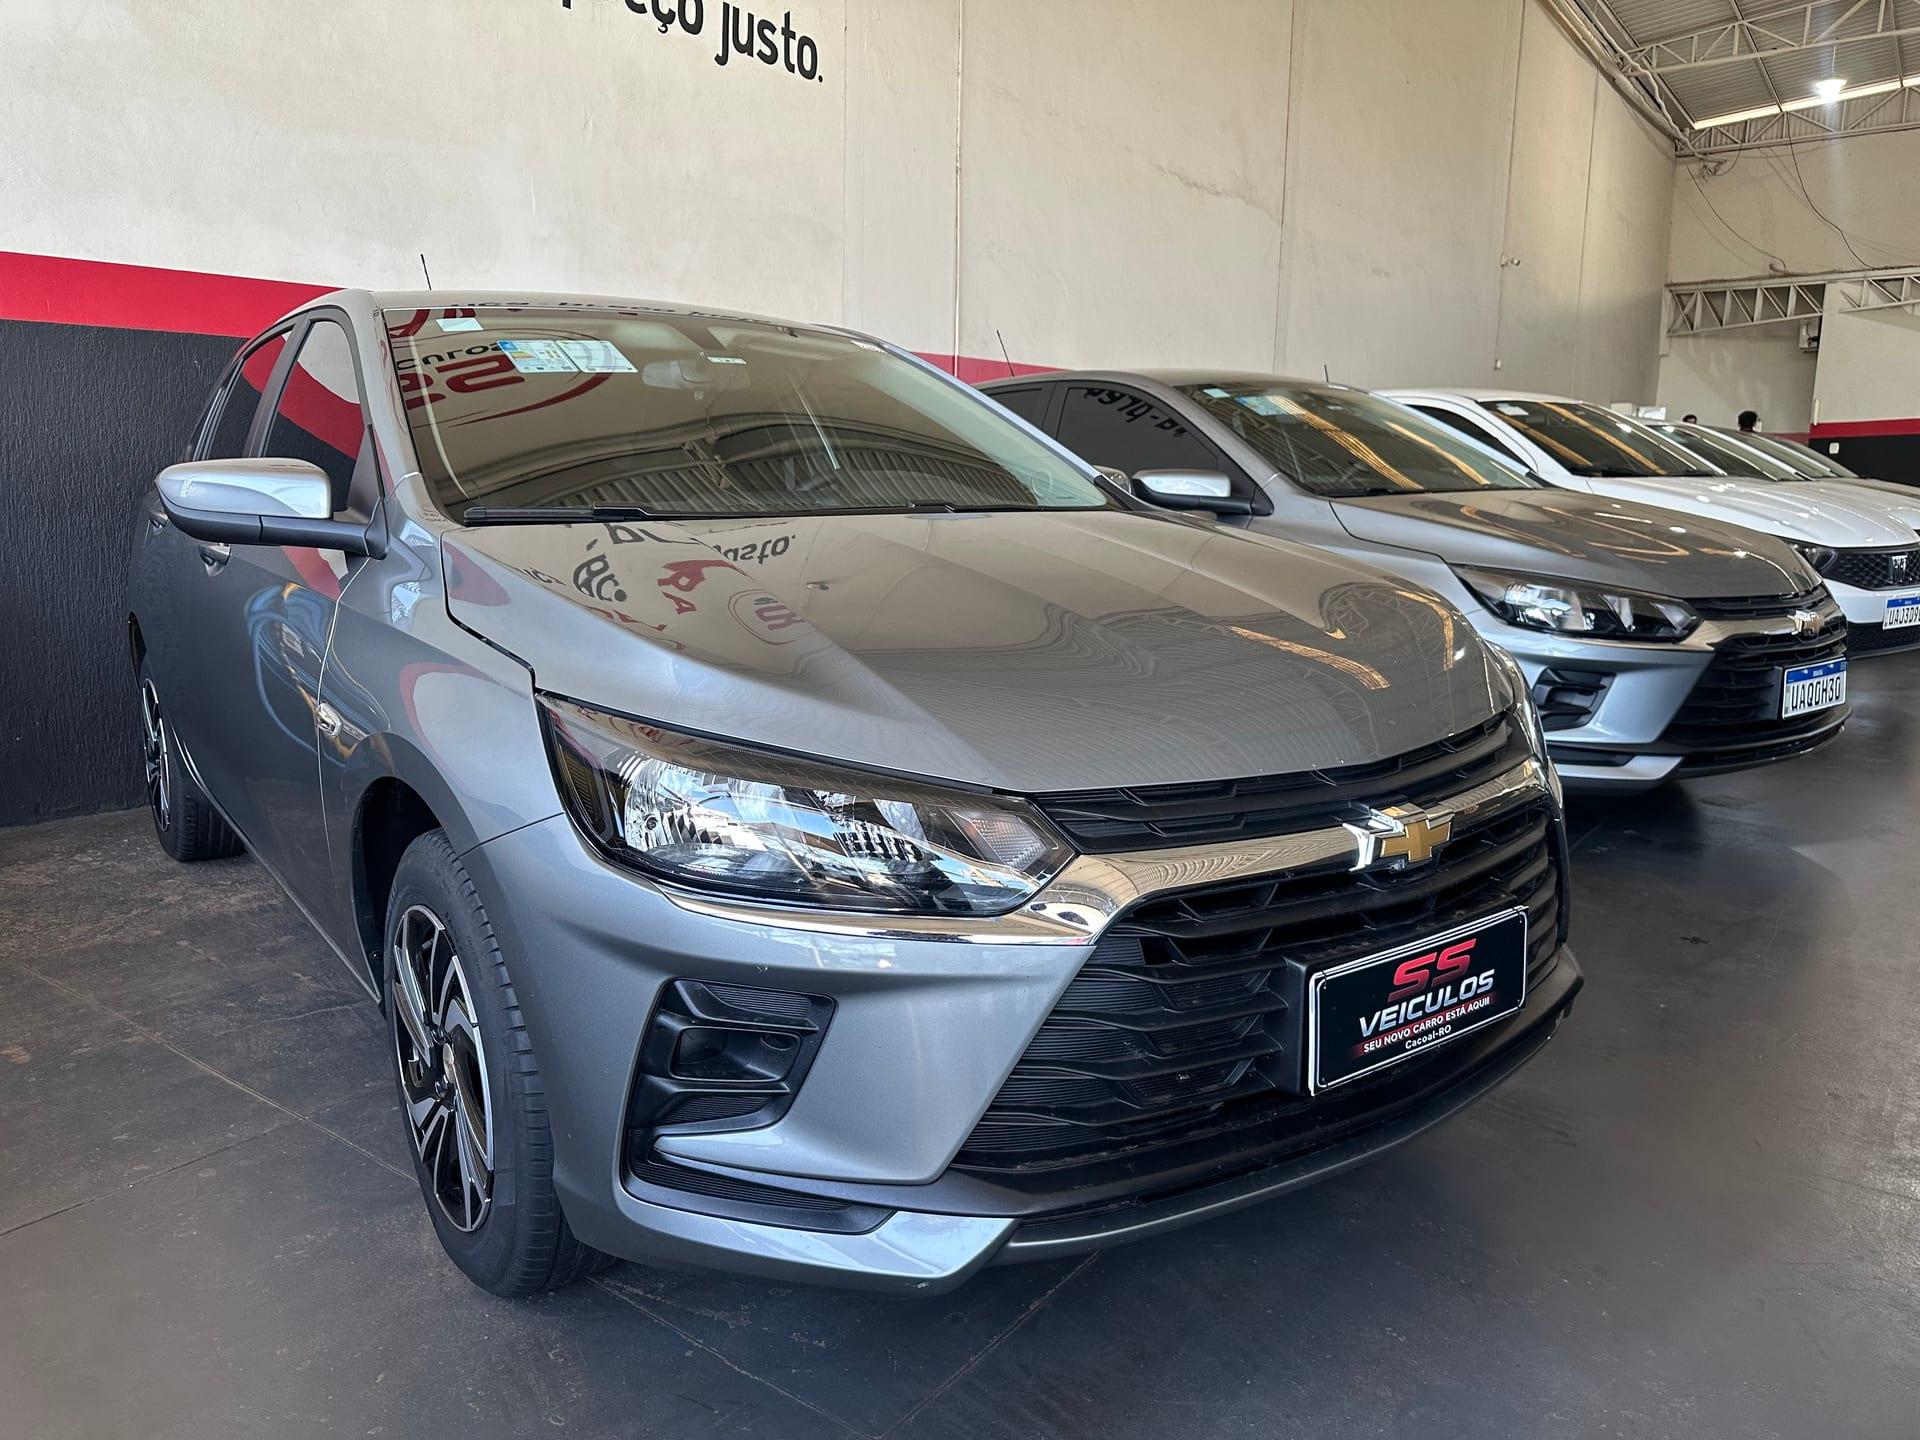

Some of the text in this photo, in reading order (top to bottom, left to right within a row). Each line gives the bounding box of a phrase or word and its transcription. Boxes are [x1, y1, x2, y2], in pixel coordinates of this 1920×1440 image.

[714, 1, 824, 83] justo.
[1888, 606, 1920, 625] UAJ3D9
[1387, 938, 1477, 1003] SS
[1359, 969, 1495, 1037] VEICULOS
[1363, 1037, 1382, 1053] SEU
[1384, 1028, 1411, 1045] NOVO
[1412, 1015, 1444, 1033] CARRO
[1445, 1003, 1467, 1021] ESTÁ
[1405, 1025, 1452, 1050] Cacoal-RO
